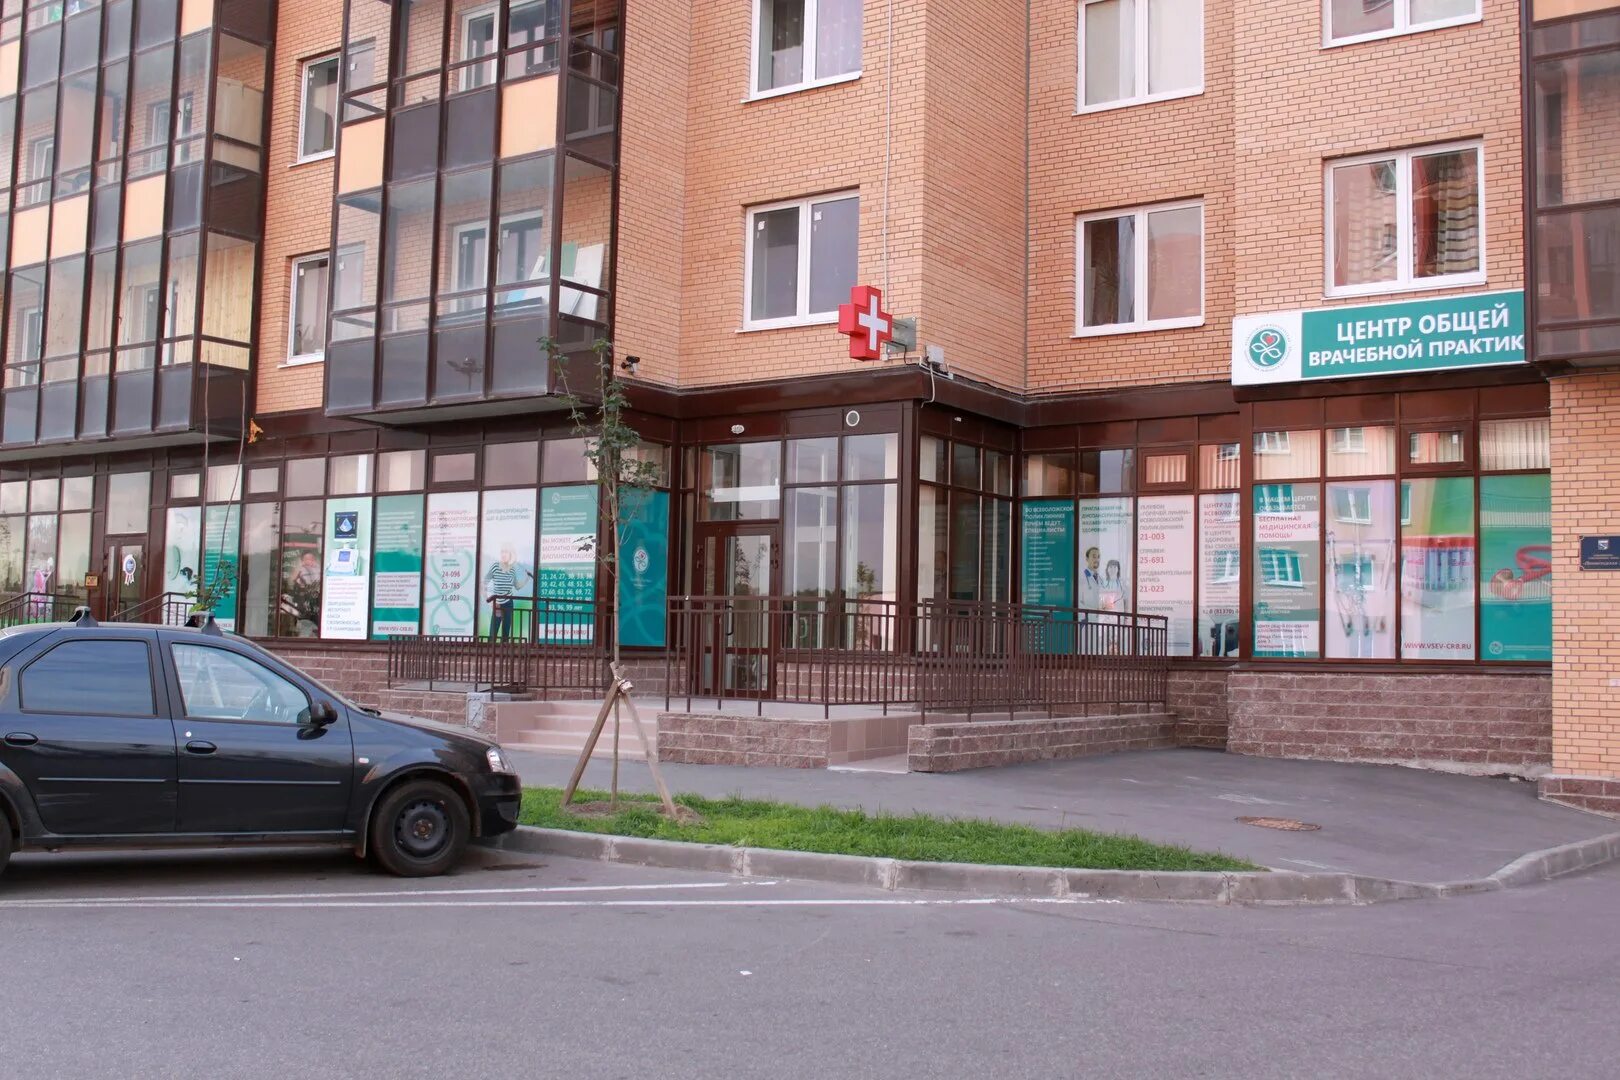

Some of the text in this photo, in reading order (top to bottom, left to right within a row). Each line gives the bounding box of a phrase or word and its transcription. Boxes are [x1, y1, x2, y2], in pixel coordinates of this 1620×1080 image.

[1337, 303, 1509, 344] ЦЕНТР ОБЩЕЙ
[1309, 339, 1422, 367] ВРАЧЕБНОЙ
[1429, 334, 1524, 357] ПРАКТИК
[1259, 523, 1311, 531] МЕДИЦИНСКАЯ
[1139, 556, 1164, 564] 25-691
